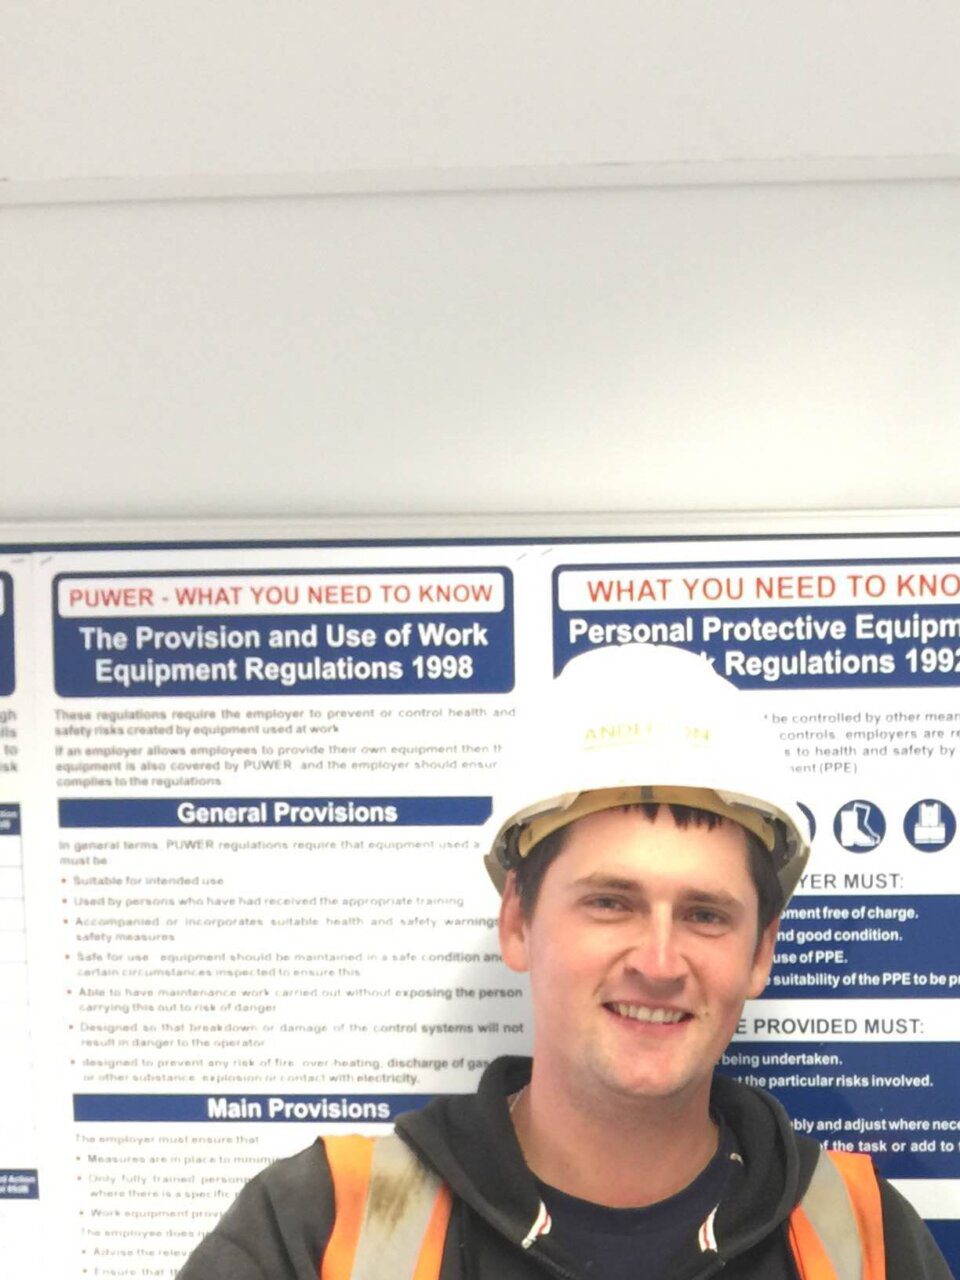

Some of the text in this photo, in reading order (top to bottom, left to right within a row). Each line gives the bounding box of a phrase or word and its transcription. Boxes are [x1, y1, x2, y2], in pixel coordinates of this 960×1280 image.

[69, 588, 153, 607] PUWER
[175, 587, 242, 605] WHAT
[250, 586, 299, 605] YOU
[307, 585, 371, 604] NEED
[380, 584, 411, 603] TO
[418, 584, 492, 602] KNOW
[587, 579, 672, 602] WHAT
[682, 577, 743, 600] YOU
[755, 575, 835, 598] NEED
[847, 574, 886, 598] TO
[78, 622, 488, 650] The Provision and Use of Work
[569, 617, 693, 649] Personal
[702, 614, 846, 641] Protective
[95, 654, 473, 687] Equipment Regulations 1998
[725, 650, 895, 677] Regulations
[771, 713, 788, 723] be
[791, 712, 861, 723] controlled
[865, 712, 881, 725] by
[885, 711, 920, 722] other
[54, 721, 339, 738] safety risks created by equipment used at work
[177, 801, 398, 827] General Provisions
[844, 873, 902, 888] MUST:
[823, 907, 849, 919] free
[851, 906, 866, 918] of
[866, 906, 918, 921] charge.
[796, 929, 832, 944] good
[833, 928, 902, 940] condition.
[773, 950, 847, 964] use of PPE.
[774, 972, 840, 988] suitability
[842, 972, 856, 985] of
[857, 973, 880, 985] the
[882, 972, 911, 985] PPE
[912, 973, 927, 985] to
[929, 972, 946, 984] be
[753, 1018, 857, 1033] PROVIDED
[864, 1018, 923, 1033] MUST:
[721, 1052, 842, 1067] being undertaken.
[746, 1074, 933, 1088] the particular risks involved.
[207, 1098, 390, 1120] Main Provisions
[817, 1118, 842, 1130] and
[843, 1118, 886, 1133] adjust
[888, 1118, 930, 1130] where
[833, 1140, 854, 1151] the
[858, 1140, 887, 1151] task
[891, 1142, 906, 1151] or
[910, 1140, 936, 1151] add
[939, 1140, 954, 1151] to
